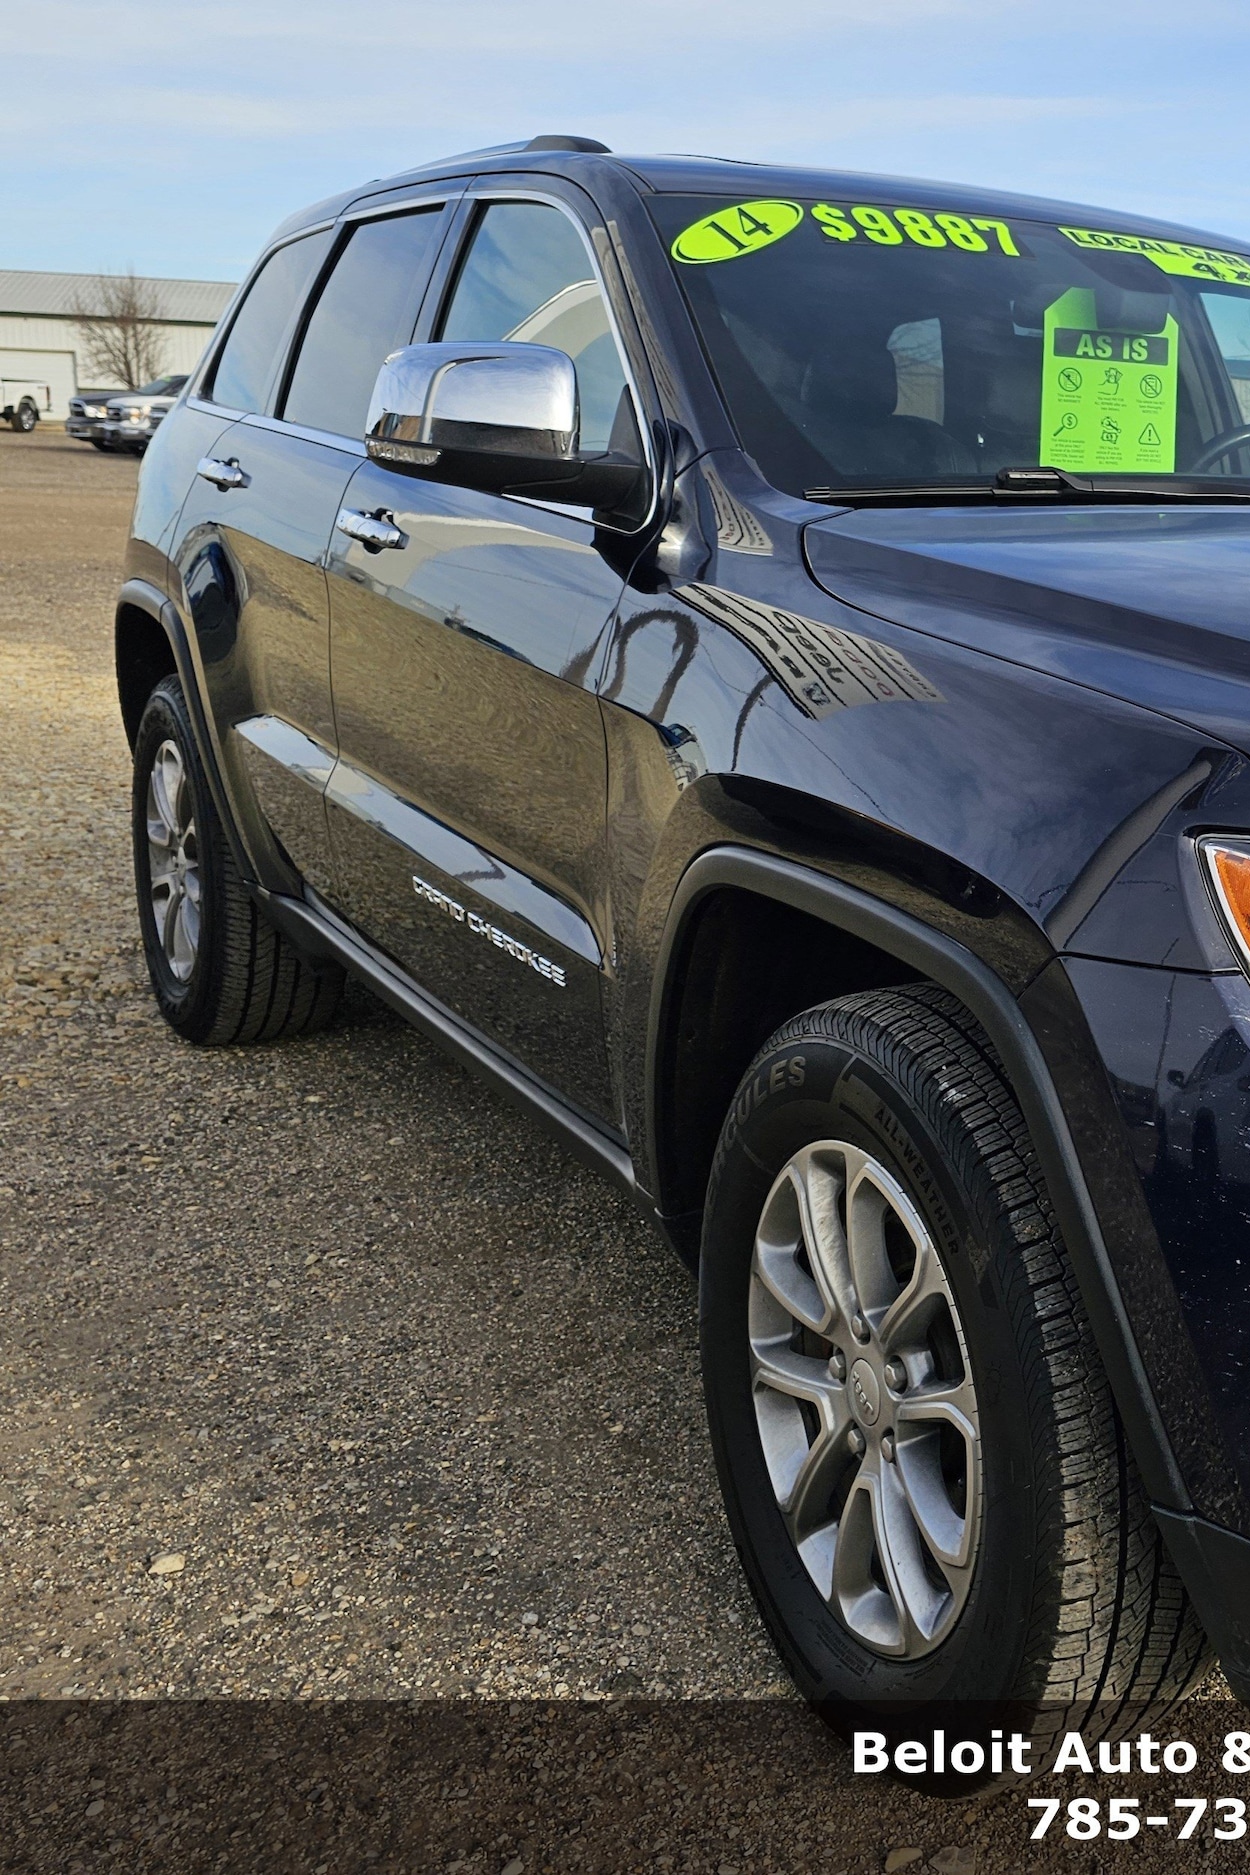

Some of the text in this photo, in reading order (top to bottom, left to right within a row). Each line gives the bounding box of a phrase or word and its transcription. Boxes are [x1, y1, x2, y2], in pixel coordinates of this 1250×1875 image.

[702, 206, 774, 253] 14
[810, 203, 1021, 257] $9887
[1068, 230, 1245, 269] LOCAL CAR
[1076, 333, 1149, 362] AS IS
[412, 875, 567, 987] GRAND CHEROKEE
[873, 1107, 959, 1257] ALL-WEATHER
